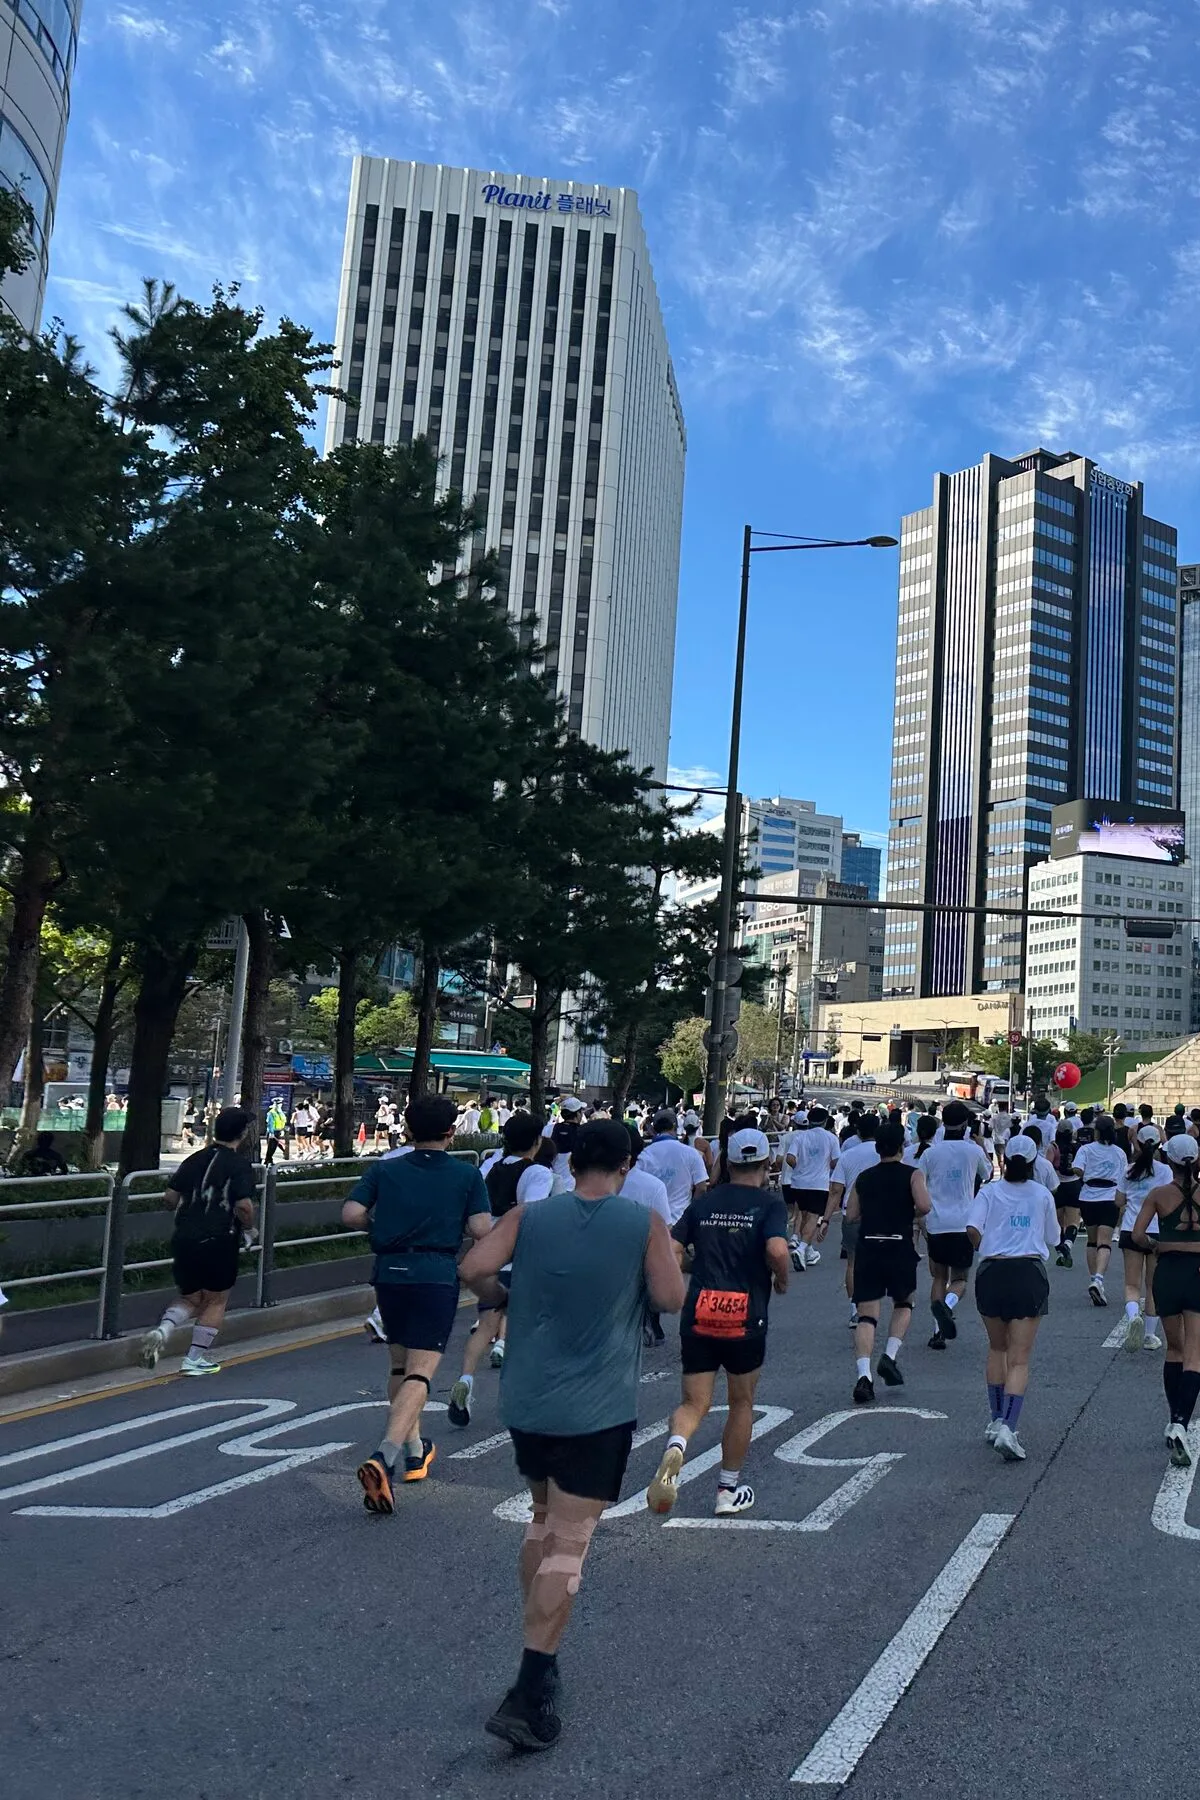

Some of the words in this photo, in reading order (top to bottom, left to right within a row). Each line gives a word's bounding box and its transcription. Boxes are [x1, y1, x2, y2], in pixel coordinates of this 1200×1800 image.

[481, 184, 552, 211] Planit
[556, 194, 611, 216] 플래닛
[710, 1297, 745, 1314] 34654
